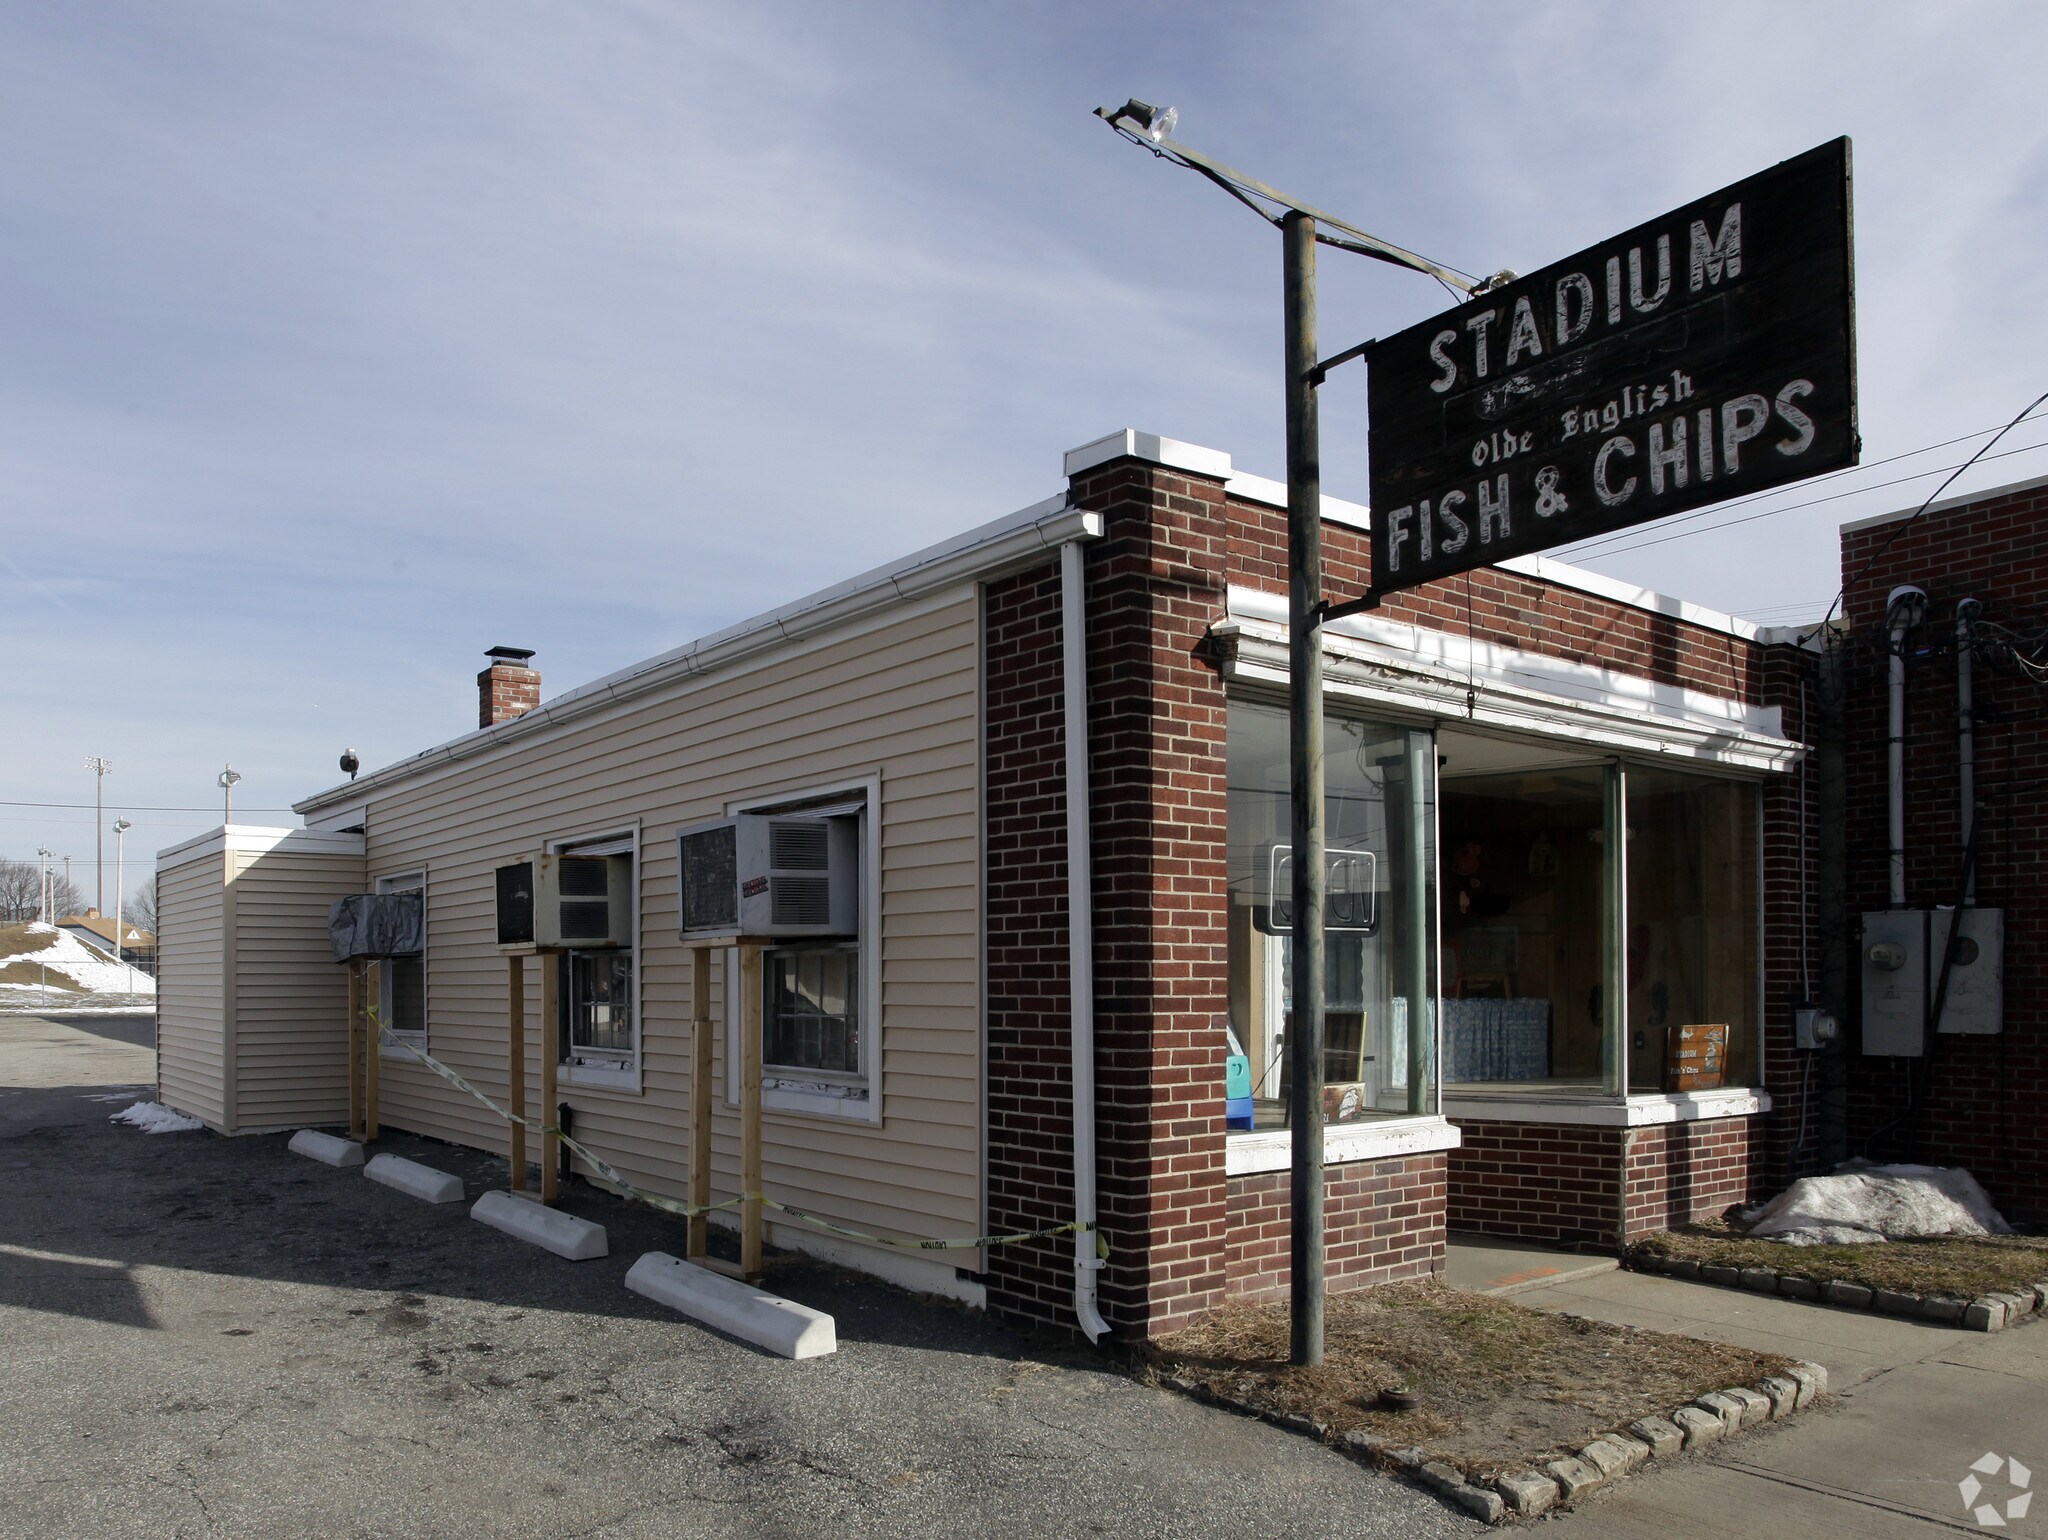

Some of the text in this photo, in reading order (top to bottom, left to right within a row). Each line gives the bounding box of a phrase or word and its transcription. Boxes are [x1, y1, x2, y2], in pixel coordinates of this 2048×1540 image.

[1430, 202, 1741, 393] STADIUM
[1561, 369, 1695, 442] English
[1387, 472, 1510, 572] FISH
[1534, 465, 1569, 518] &
[1593, 379, 1816, 507] CHIPS
[1277, 855, 1372, 923] OEN
